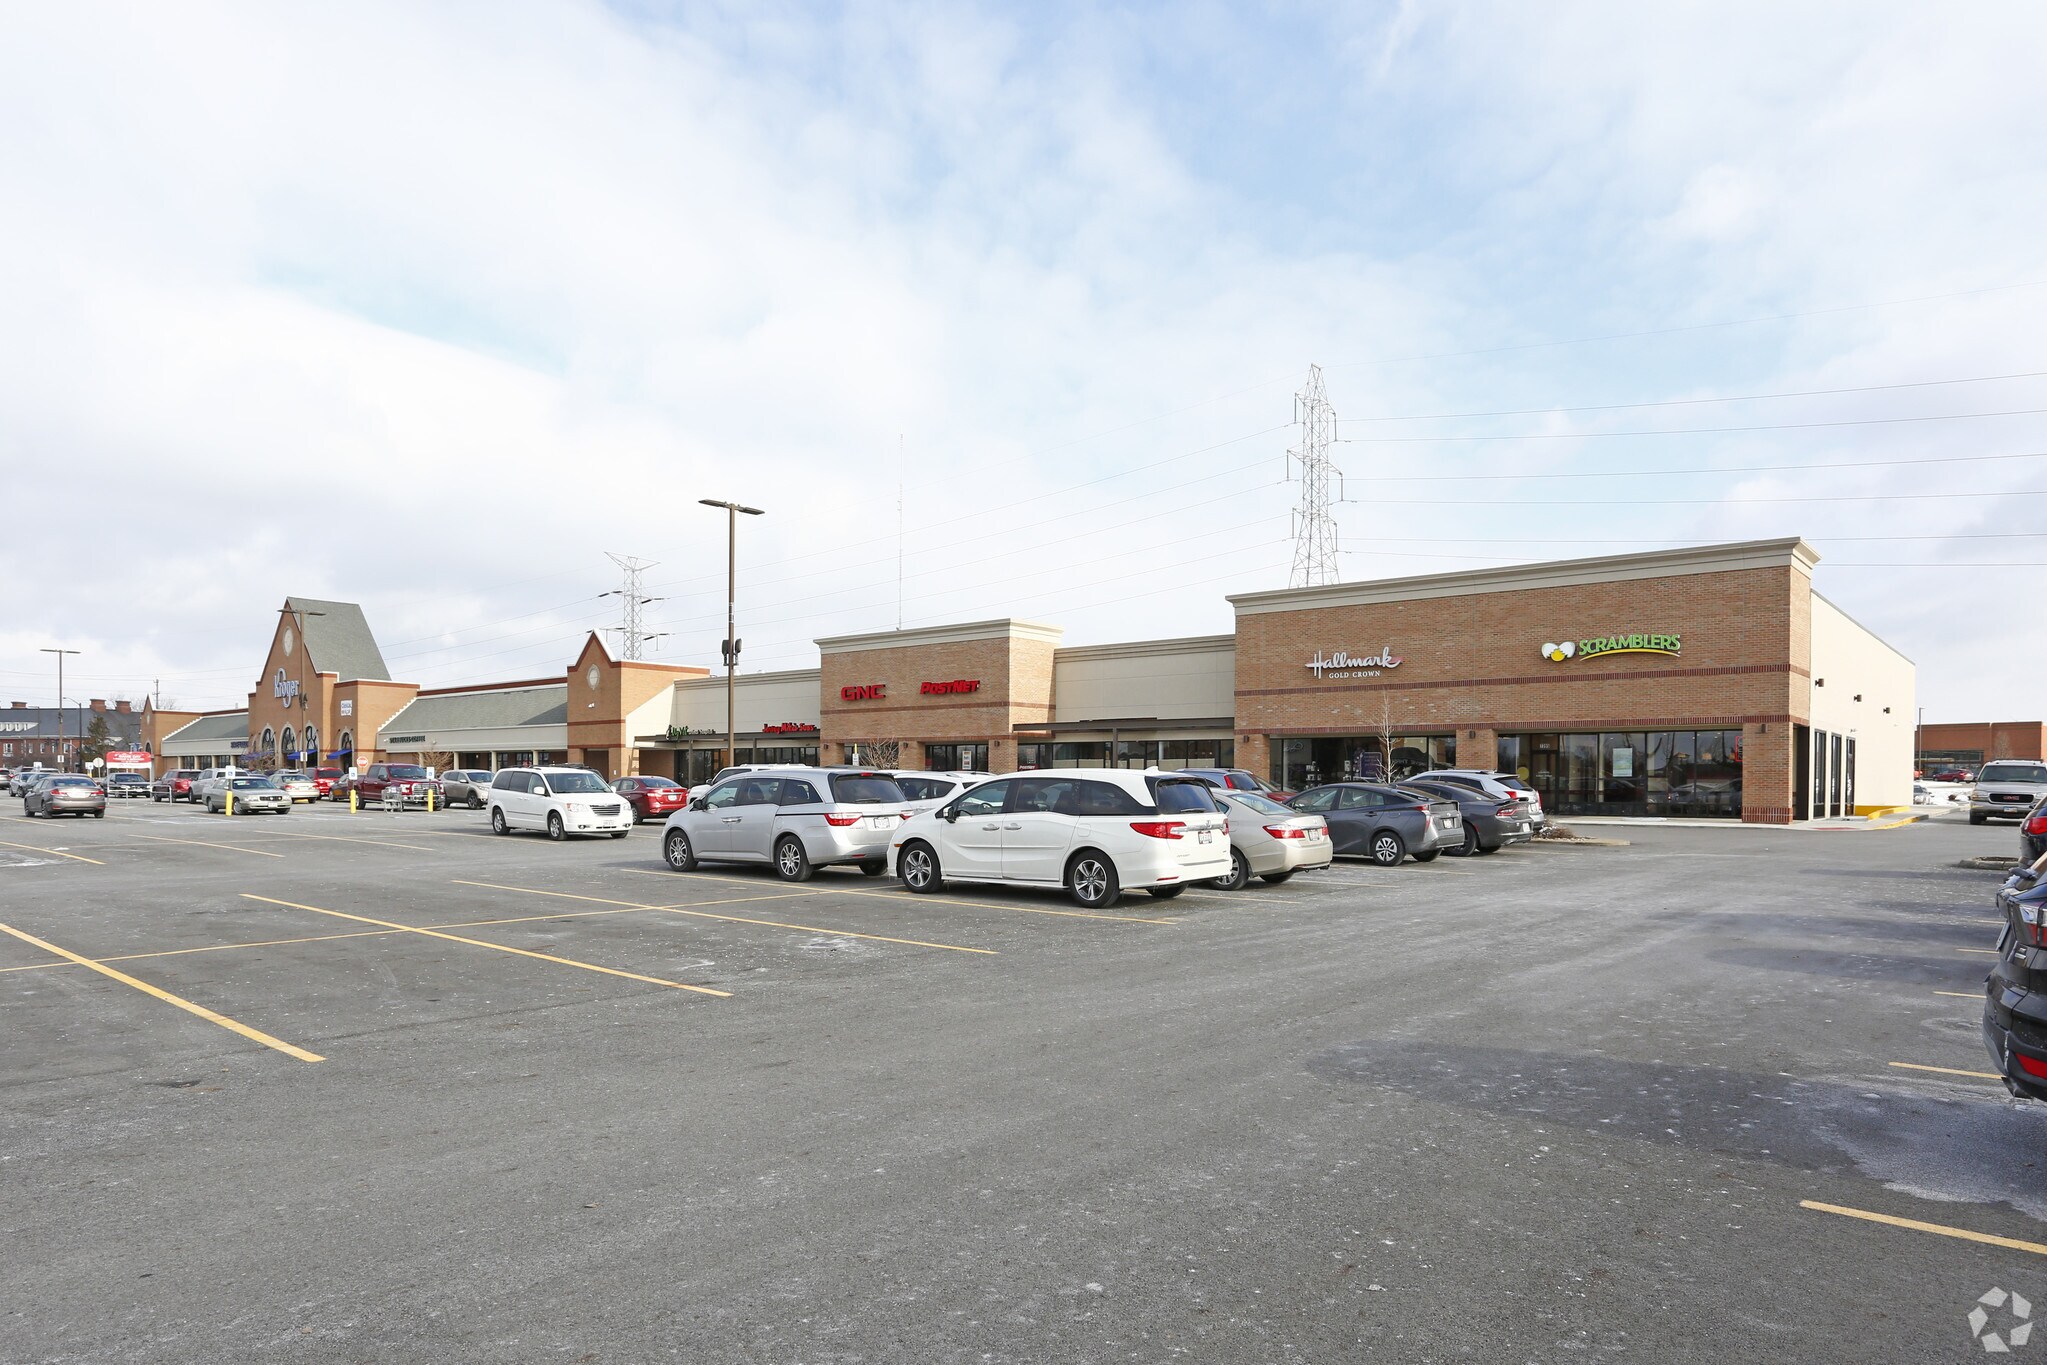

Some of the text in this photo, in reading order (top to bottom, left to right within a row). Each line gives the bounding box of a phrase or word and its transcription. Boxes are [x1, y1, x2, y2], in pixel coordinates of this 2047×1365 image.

[1579, 634, 1681, 656] SCRAMBLERS
[1305, 646, 1403, 679] Hallmark
[1352, 670, 1381, 679] CROWN
[274, 667, 300, 708] Kroger
[841, 684, 886, 701] GNC
